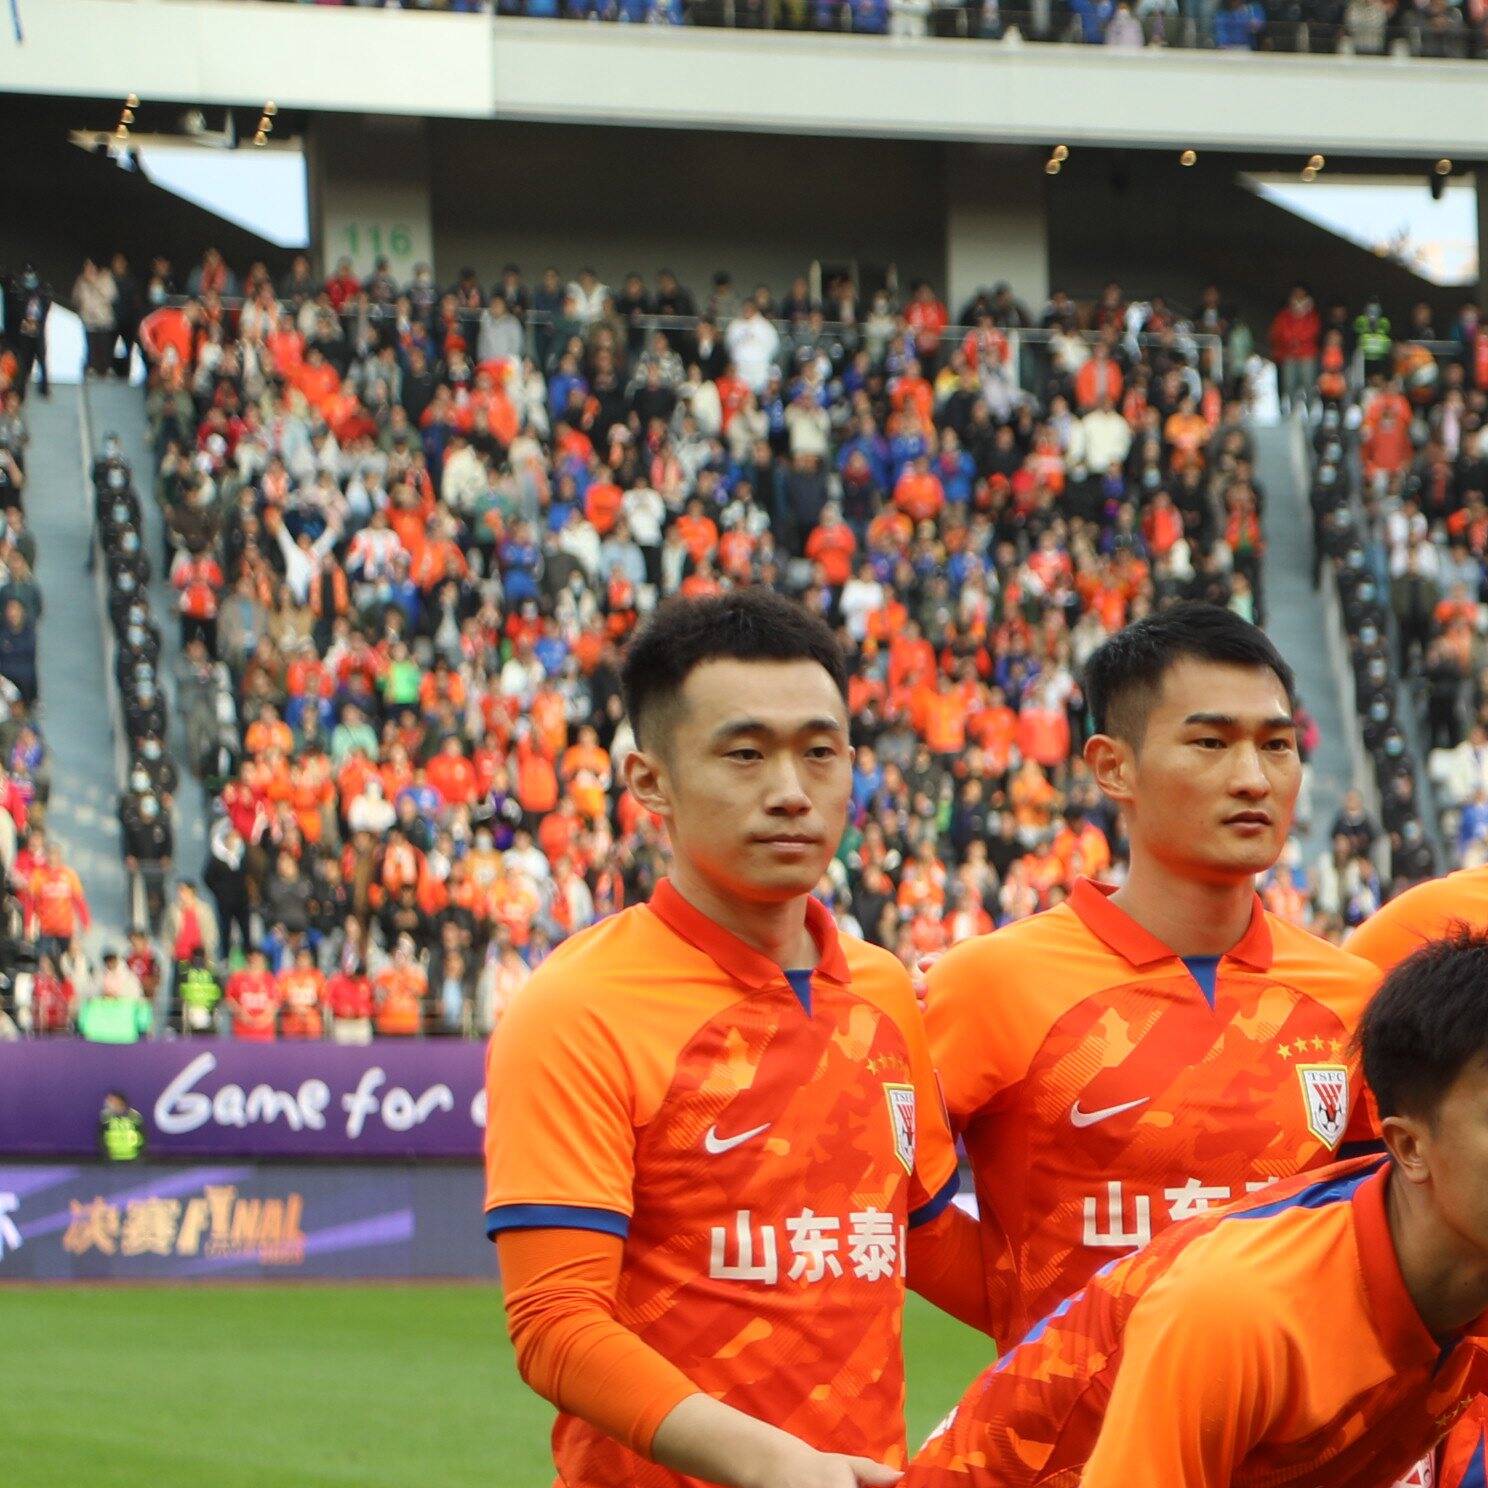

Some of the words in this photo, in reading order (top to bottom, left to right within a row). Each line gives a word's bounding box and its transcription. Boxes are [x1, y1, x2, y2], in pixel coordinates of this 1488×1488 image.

[153, 1050, 331, 1135] Game
[341, 1065, 455, 1140] for
[62, 1193, 182, 1258] 决赛
[709, 1206, 906, 1284] 山东泰
